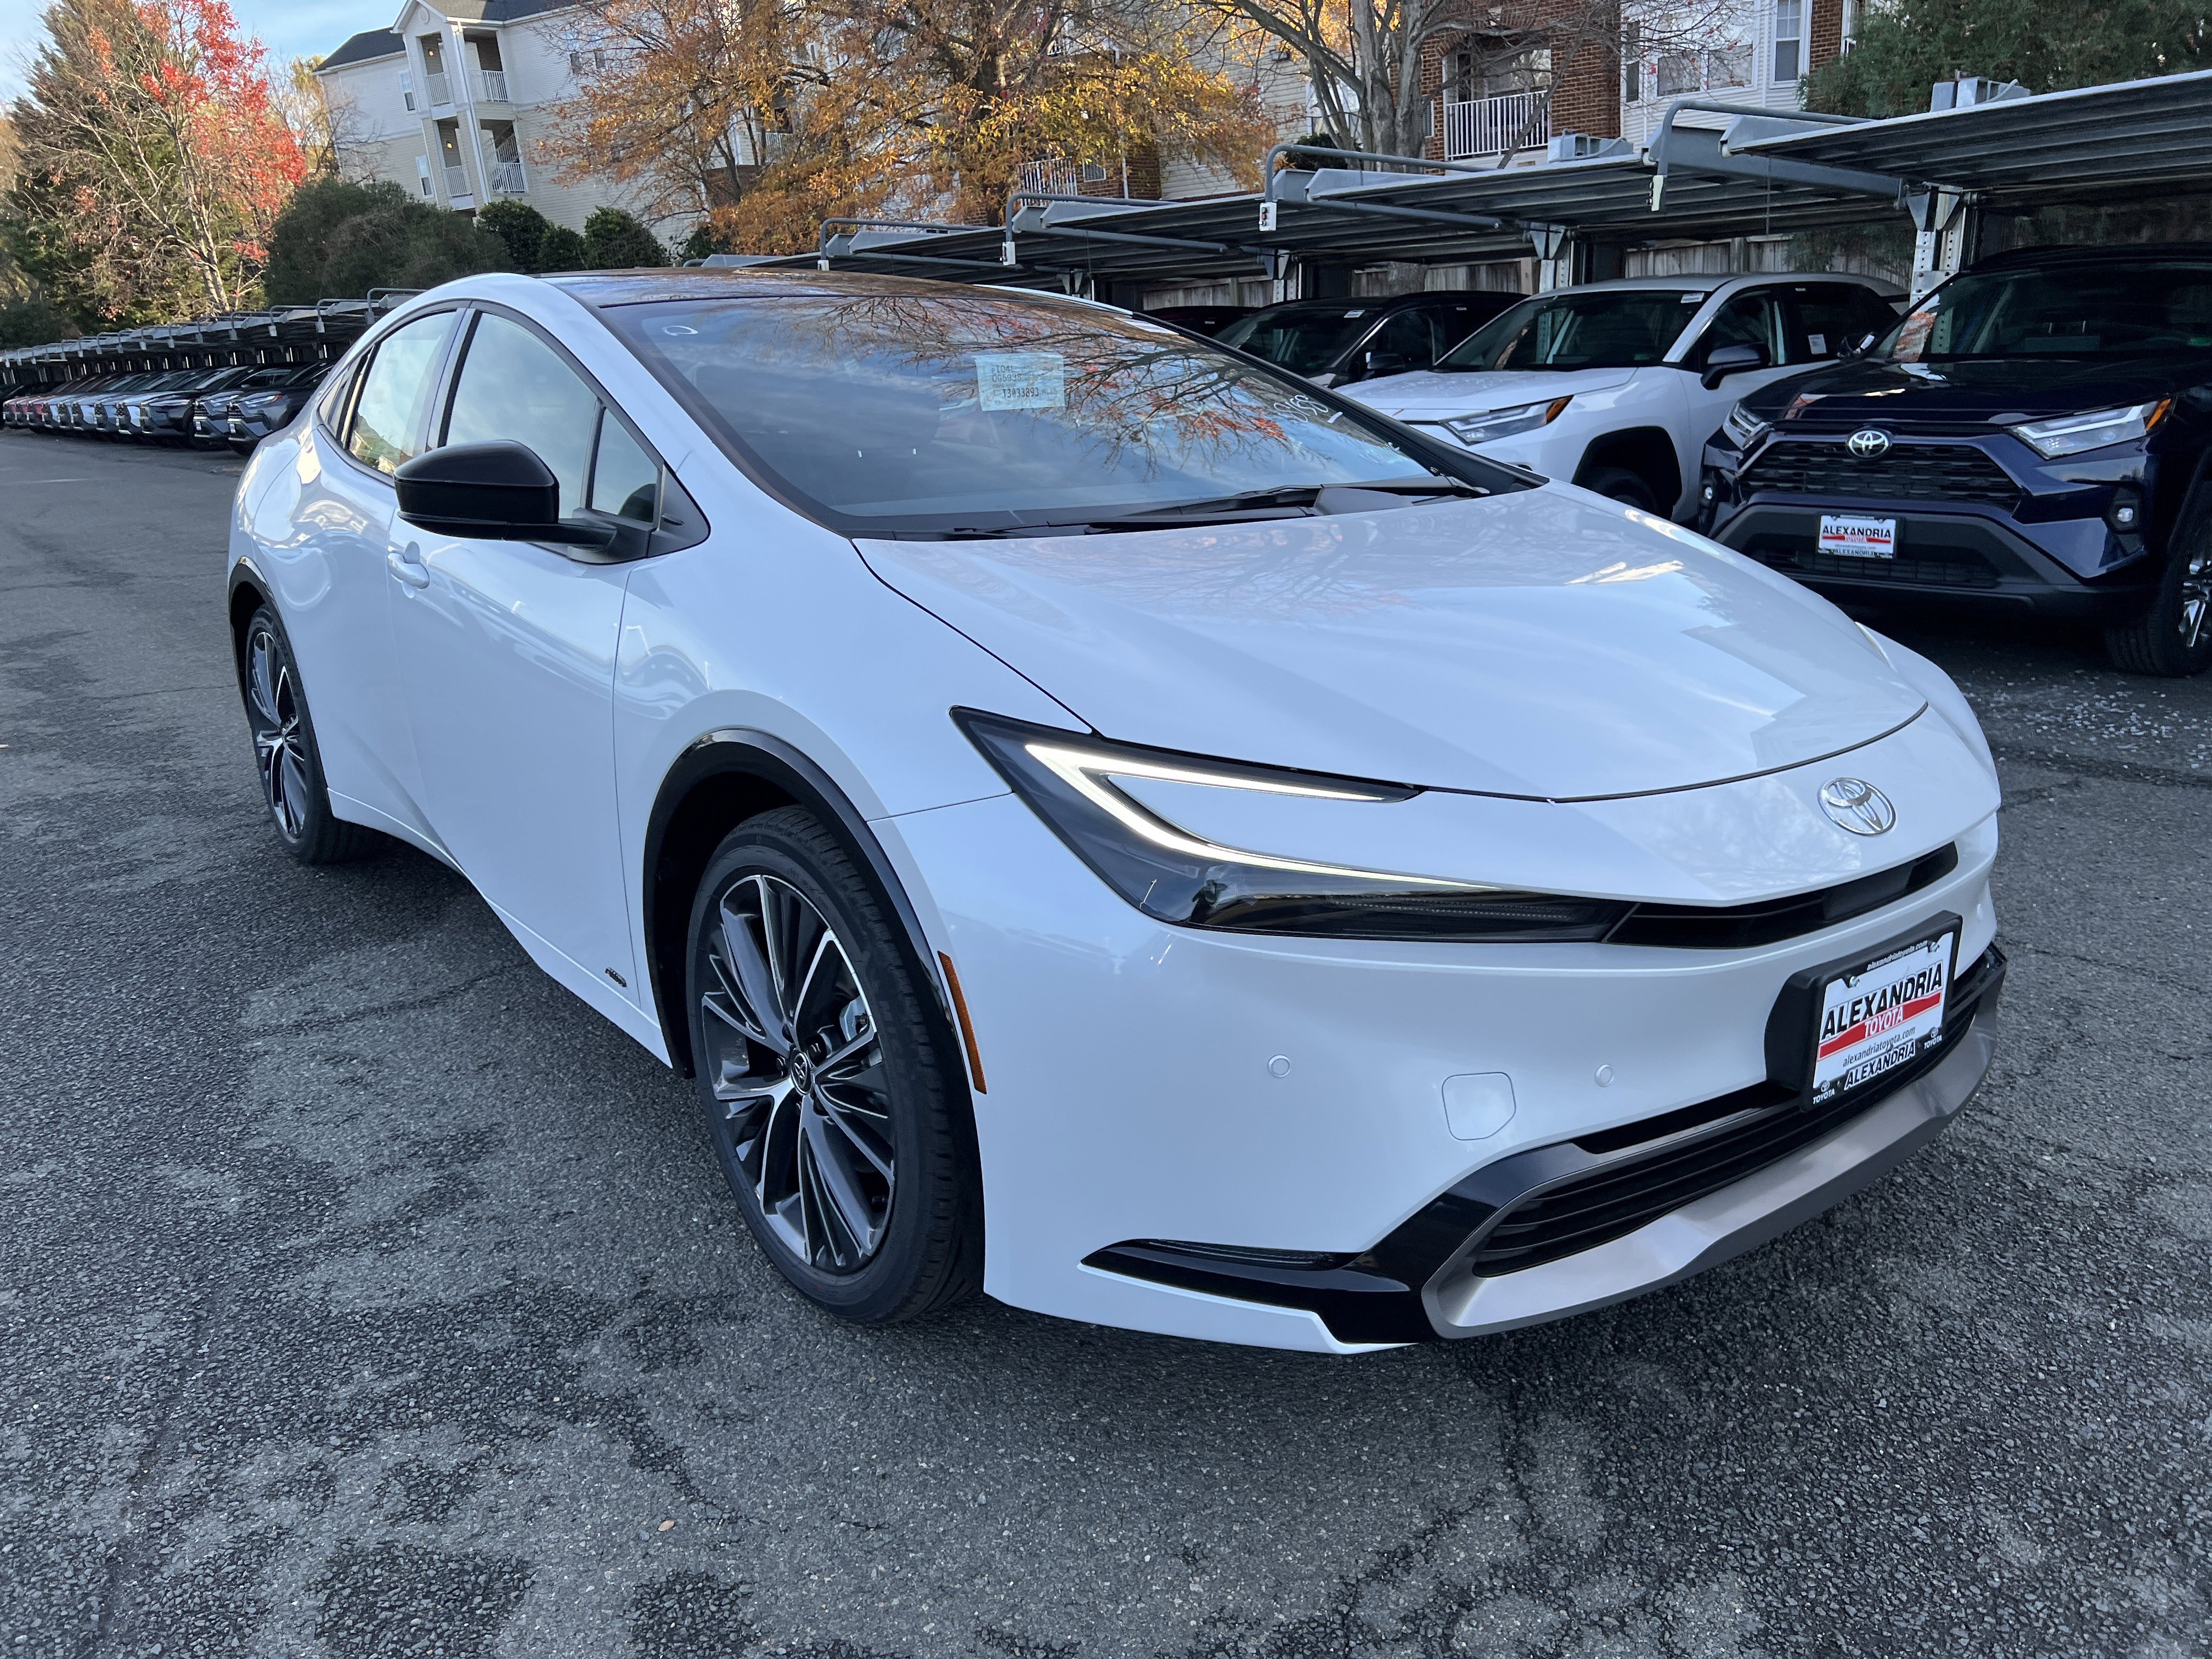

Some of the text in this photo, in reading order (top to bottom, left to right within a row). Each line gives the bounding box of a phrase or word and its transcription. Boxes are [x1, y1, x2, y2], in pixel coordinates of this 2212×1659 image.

[1822, 526, 1891, 538] ALEXANDRIA
[1821, 962, 1943, 1040] ALEXANDRIA
[1864, 1005, 1904, 1038] TOYOTA
[1843, 1026, 1915, 1067] alexandriatoyota.com
[1924, 1034, 1942, 1049] TOYOTA
[1844, 1040, 1915, 1090] ALEXANDRIA
[1813, 1088, 1835, 1105] TOYOTA
